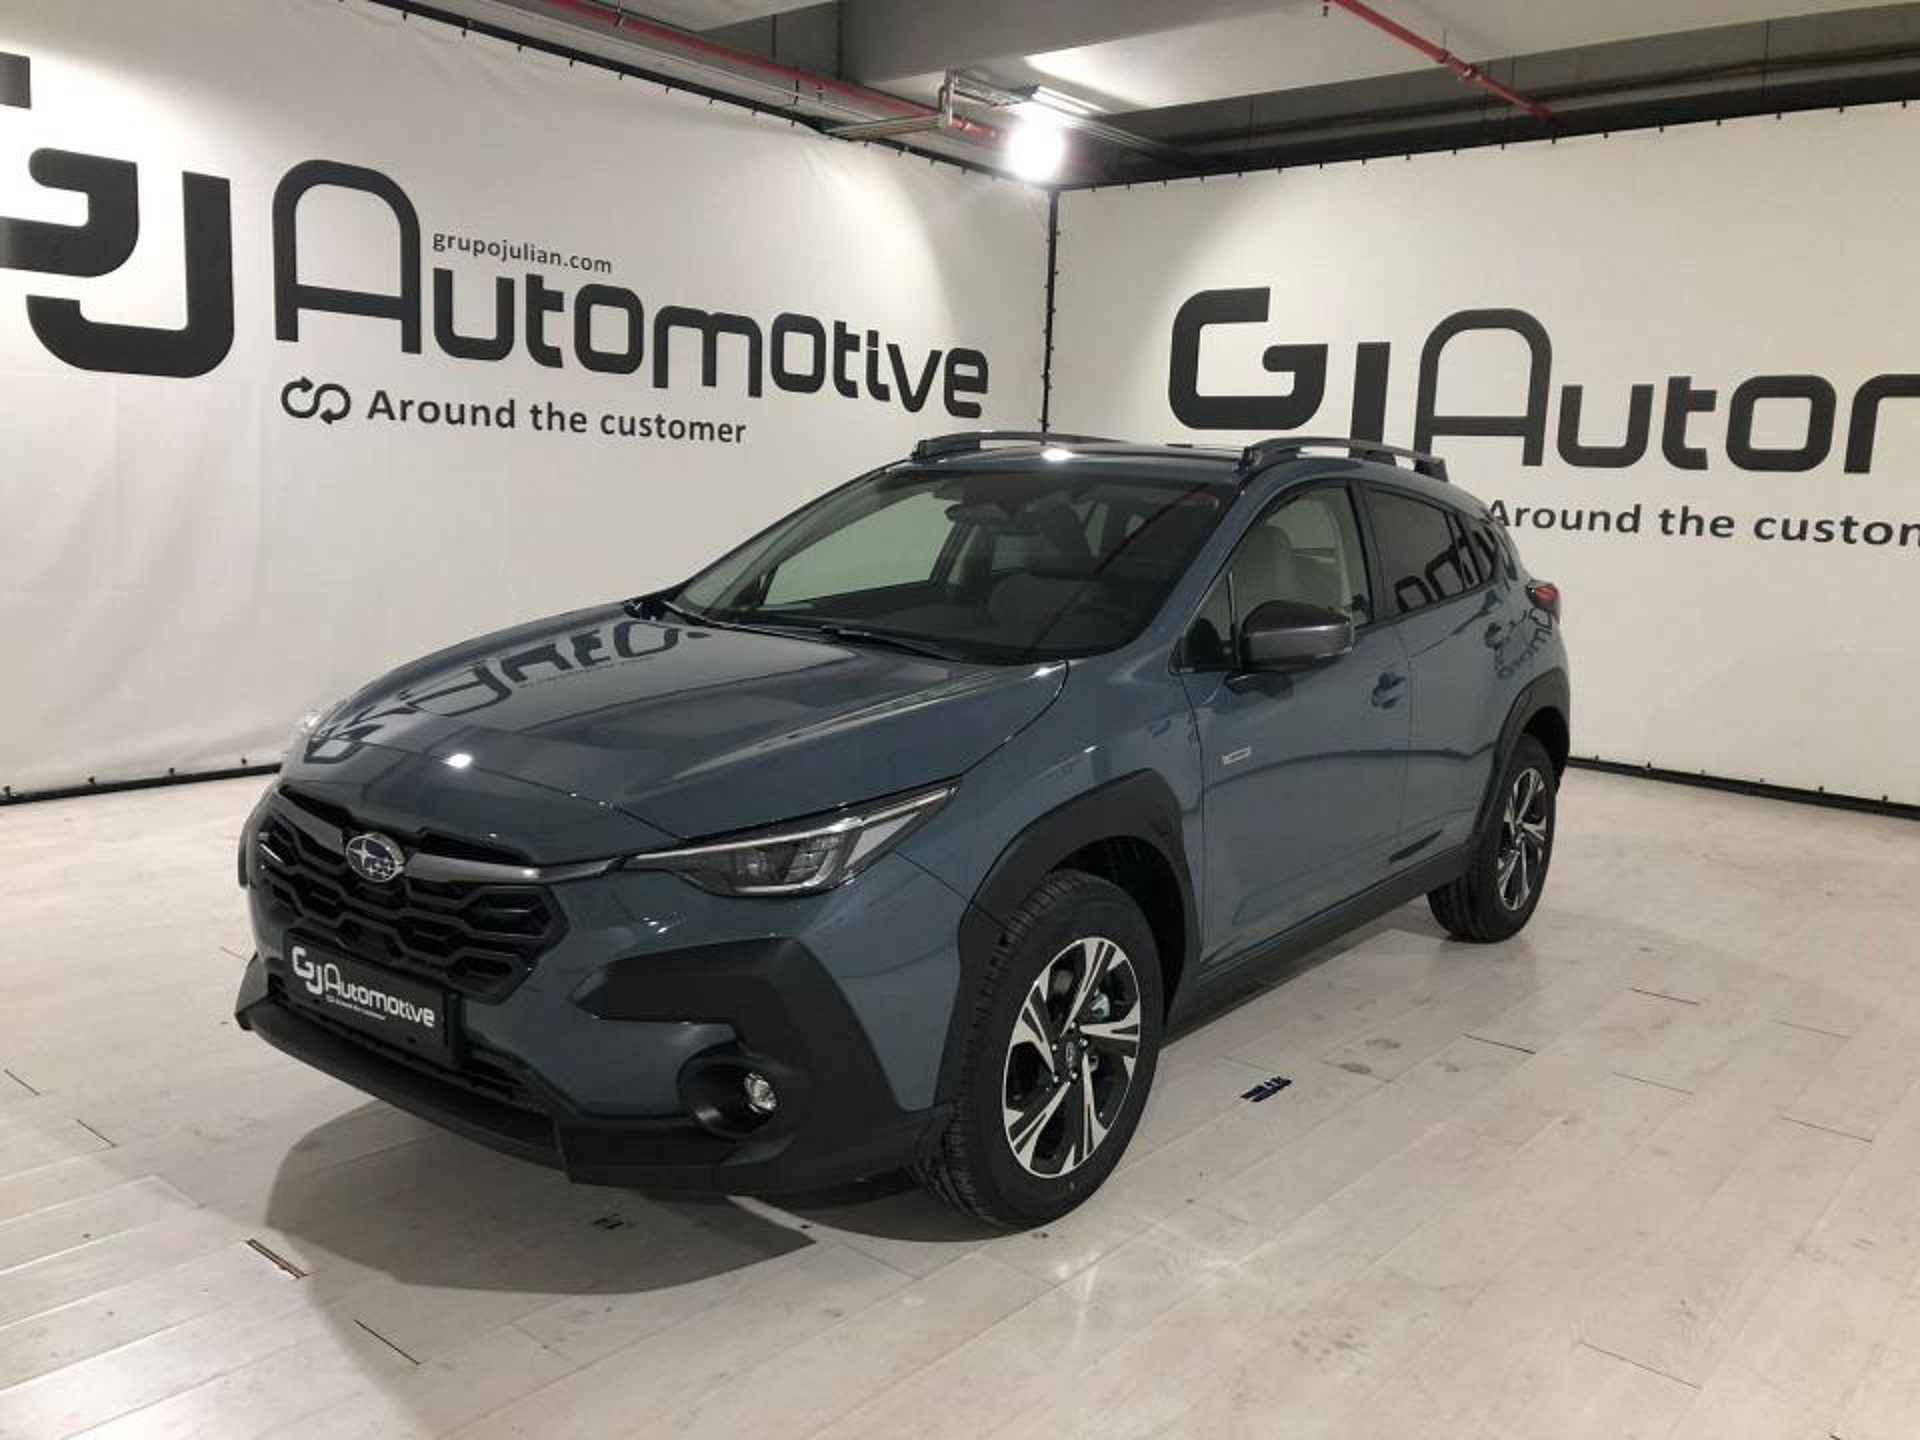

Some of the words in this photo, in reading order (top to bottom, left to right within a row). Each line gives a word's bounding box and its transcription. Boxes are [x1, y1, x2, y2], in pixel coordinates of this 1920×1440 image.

[432, 233, 612, 274] grupojulian.com
[272, 159, 989, 419] Automotive
[367, 390, 515, 429] Around
[530, 403, 587, 433] the
[600, 413, 747, 444] customer
[1489, 499, 1642, 534] Around
[1658, 505, 1735, 539] the
[323, 963, 436, 1028] Automotive
